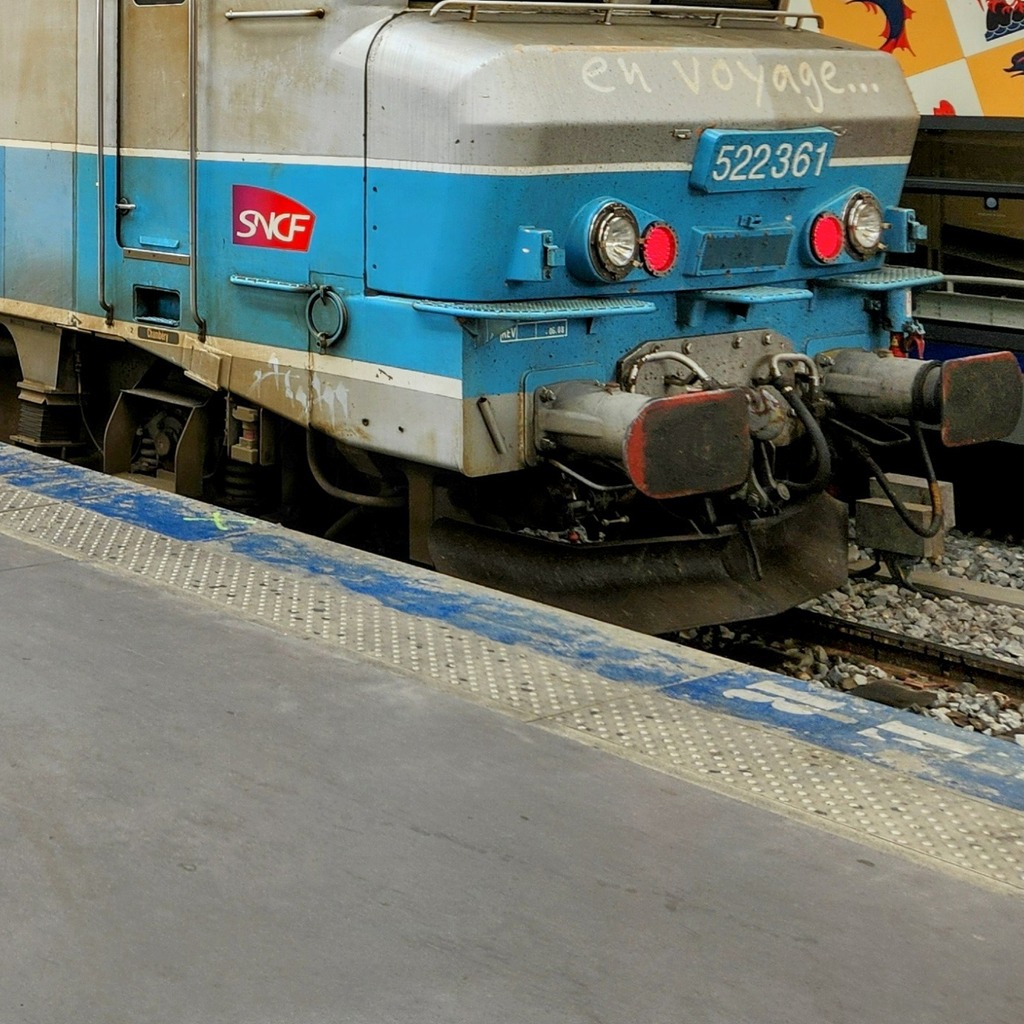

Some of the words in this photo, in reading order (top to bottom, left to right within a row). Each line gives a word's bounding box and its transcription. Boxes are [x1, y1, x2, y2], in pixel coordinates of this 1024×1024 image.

[581, 56, 652, 93] en
[672, 56, 879, 114] voyage...
[711, 141, 829, 182] 522361
[236, 209, 311, 243] SNCF
